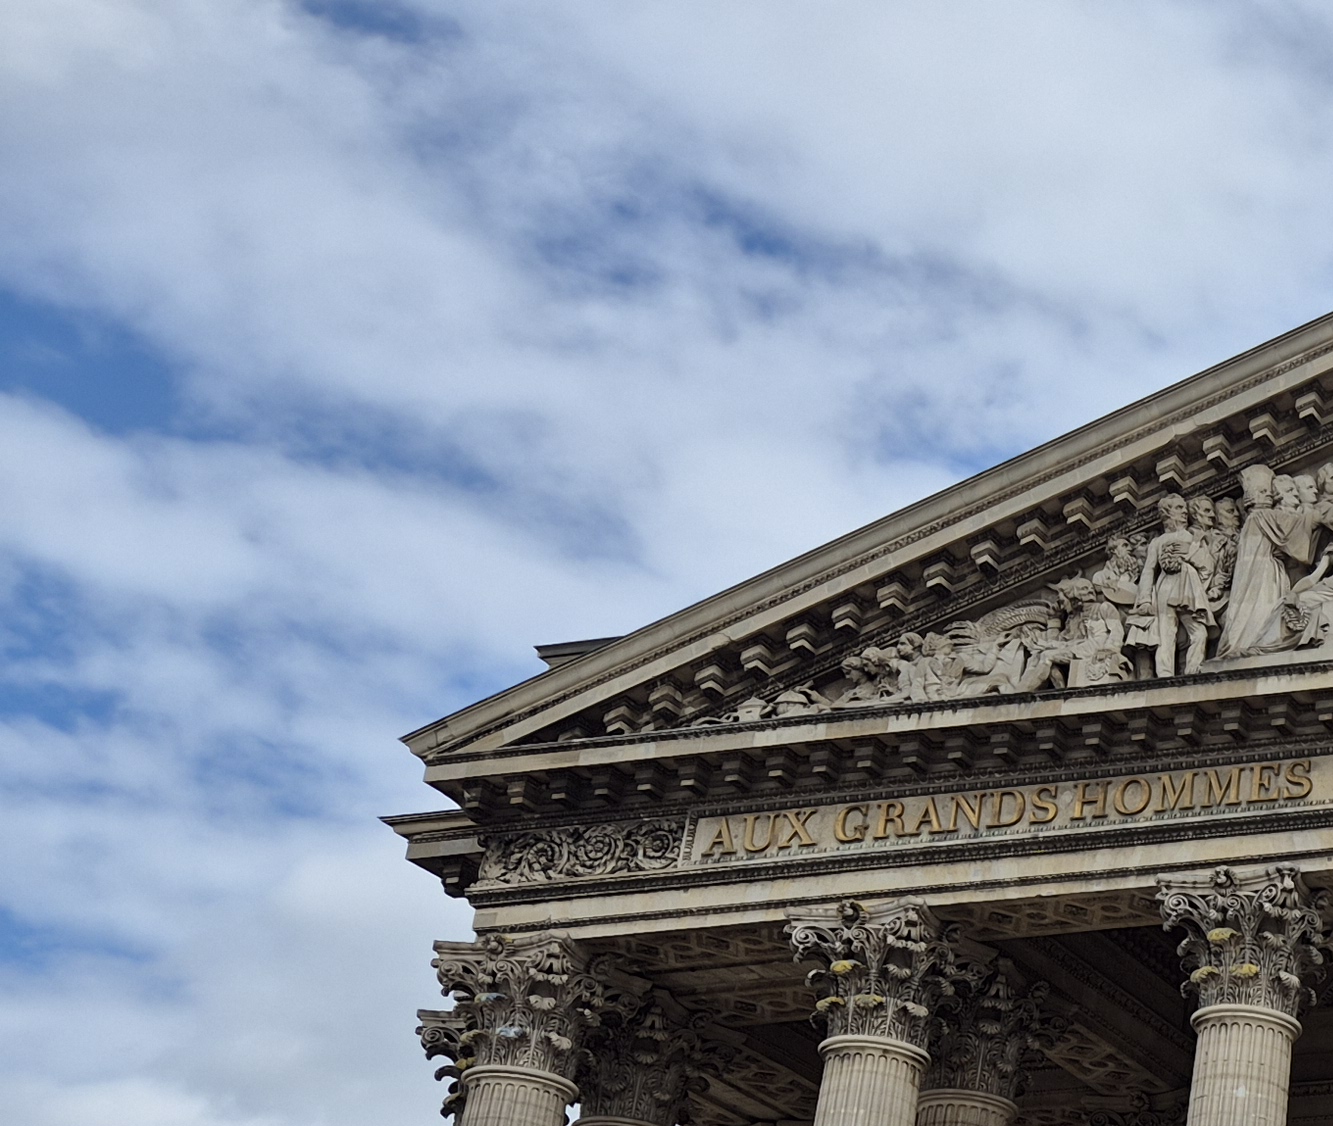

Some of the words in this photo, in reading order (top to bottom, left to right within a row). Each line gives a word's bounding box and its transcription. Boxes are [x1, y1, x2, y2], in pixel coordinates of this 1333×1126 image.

[703, 808, 818, 855] AUX
[835, 785, 1060, 842] GRANDS
[1070, 759, 1314, 820] HOMMES
